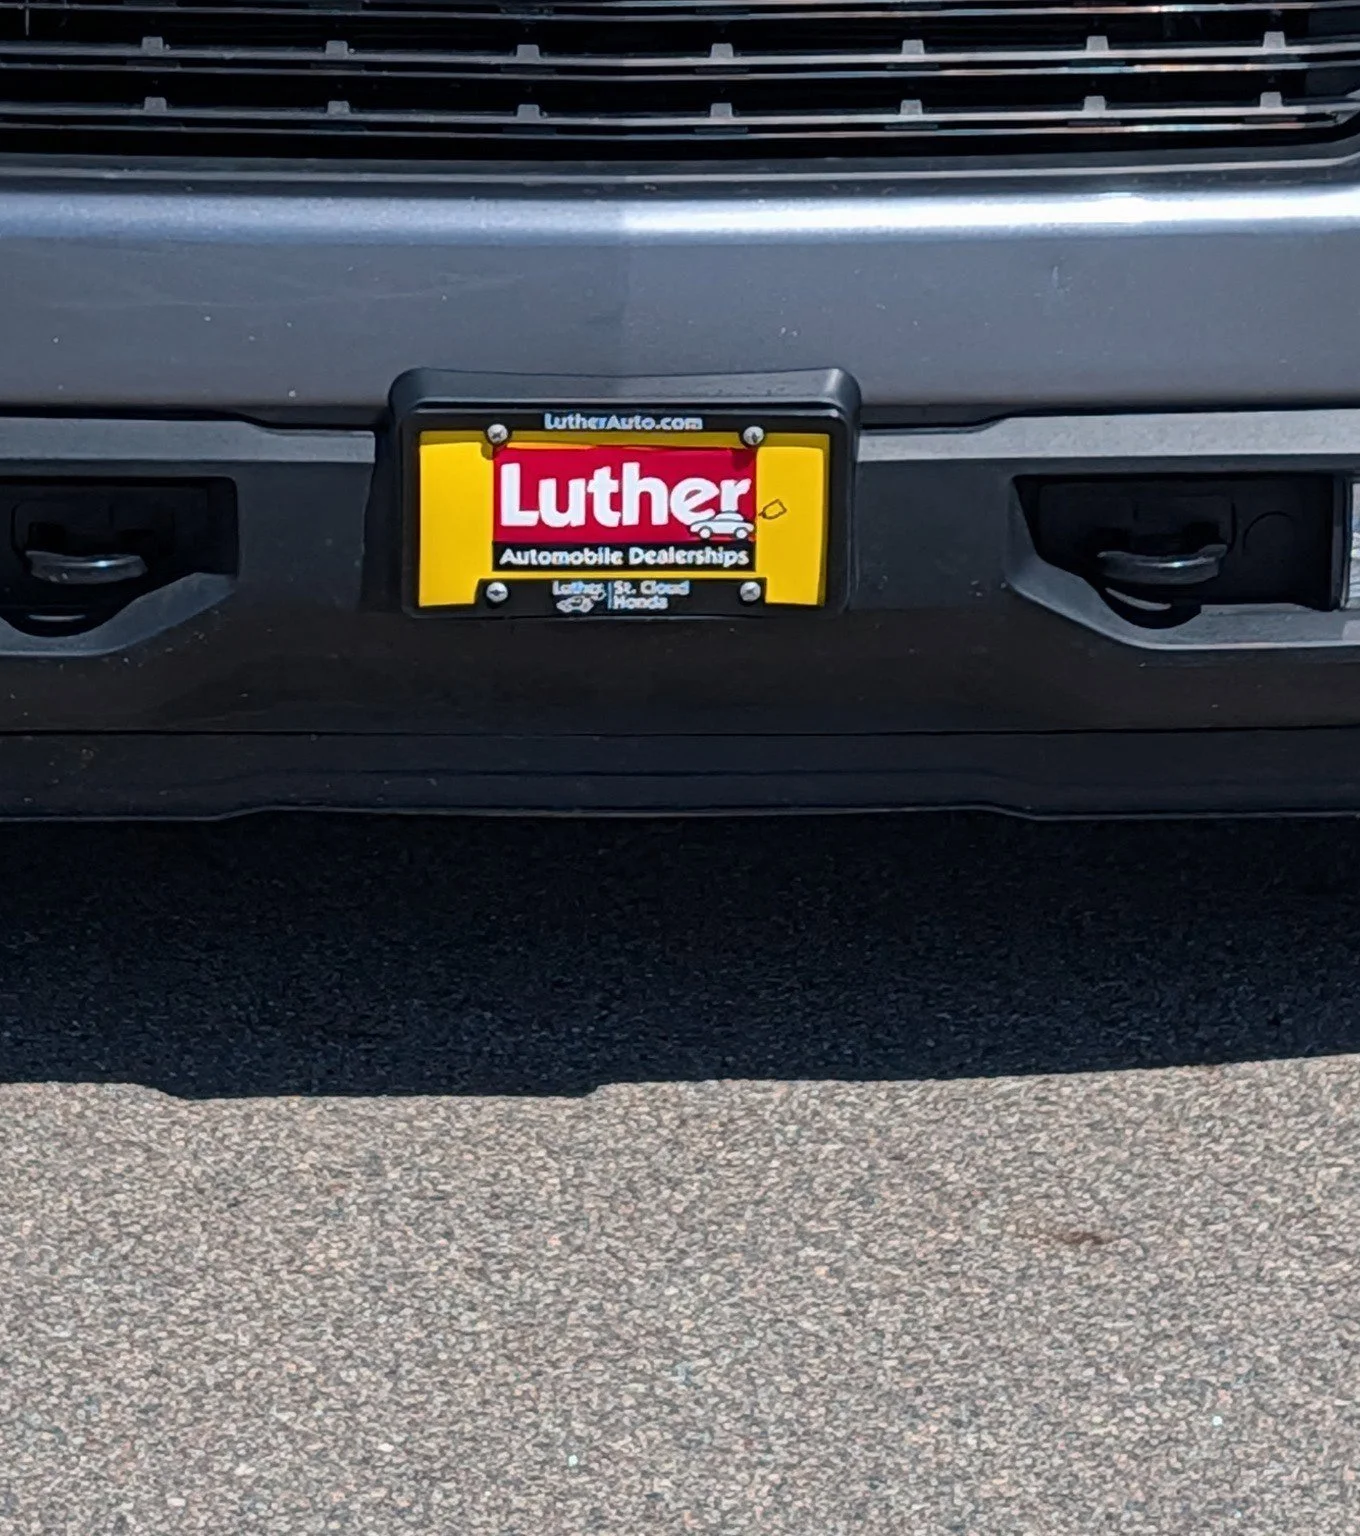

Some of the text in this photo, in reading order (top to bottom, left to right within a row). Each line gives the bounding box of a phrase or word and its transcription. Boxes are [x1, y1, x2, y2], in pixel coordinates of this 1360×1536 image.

[544, 413, 703, 430] LutherAuto.com
[500, 461, 752, 528] Luther
[499, 546, 750, 568] Automobile Dealerships
